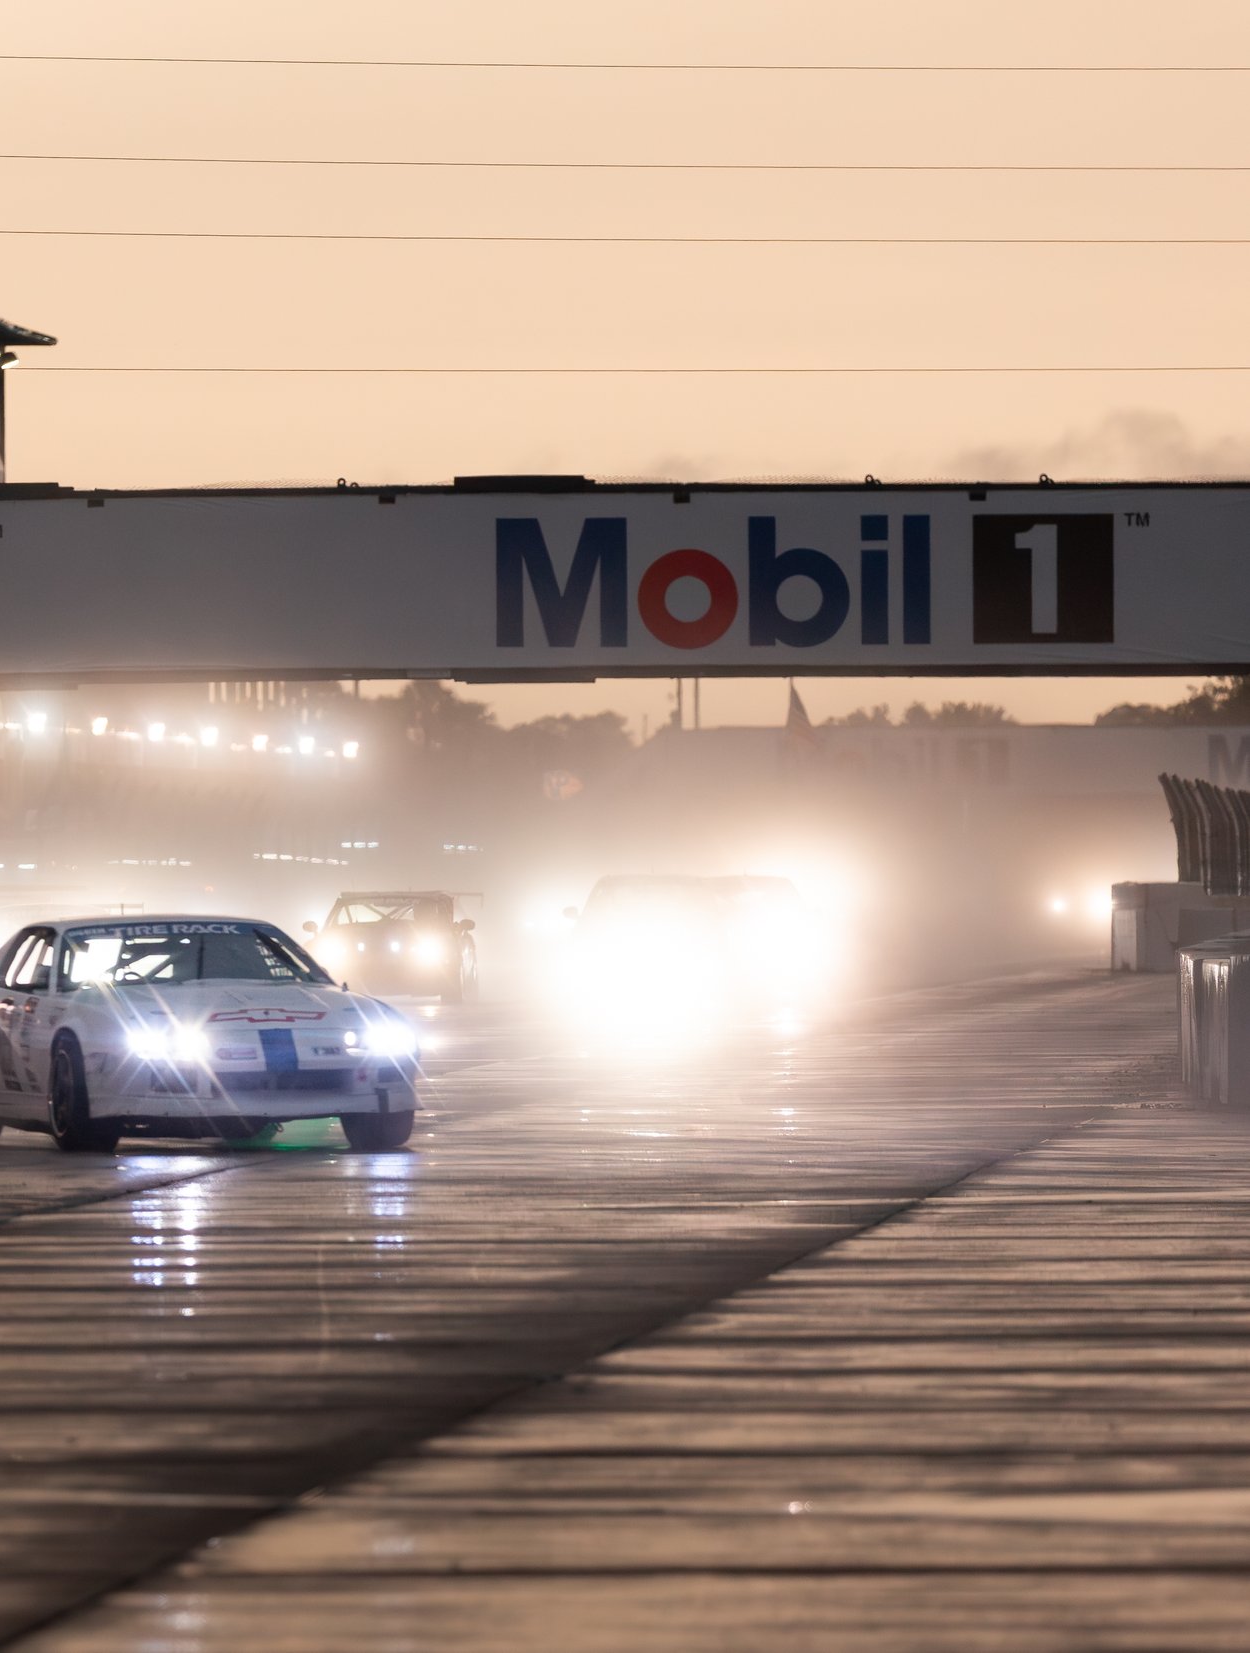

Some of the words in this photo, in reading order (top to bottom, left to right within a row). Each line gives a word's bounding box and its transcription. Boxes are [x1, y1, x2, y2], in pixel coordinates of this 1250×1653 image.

[496, 513, 931, 650] Mobil
[1123, 511, 1150, 527] TM
[109, 924, 169, 937] TIRE
[172, 924, 241, 934] RACK
